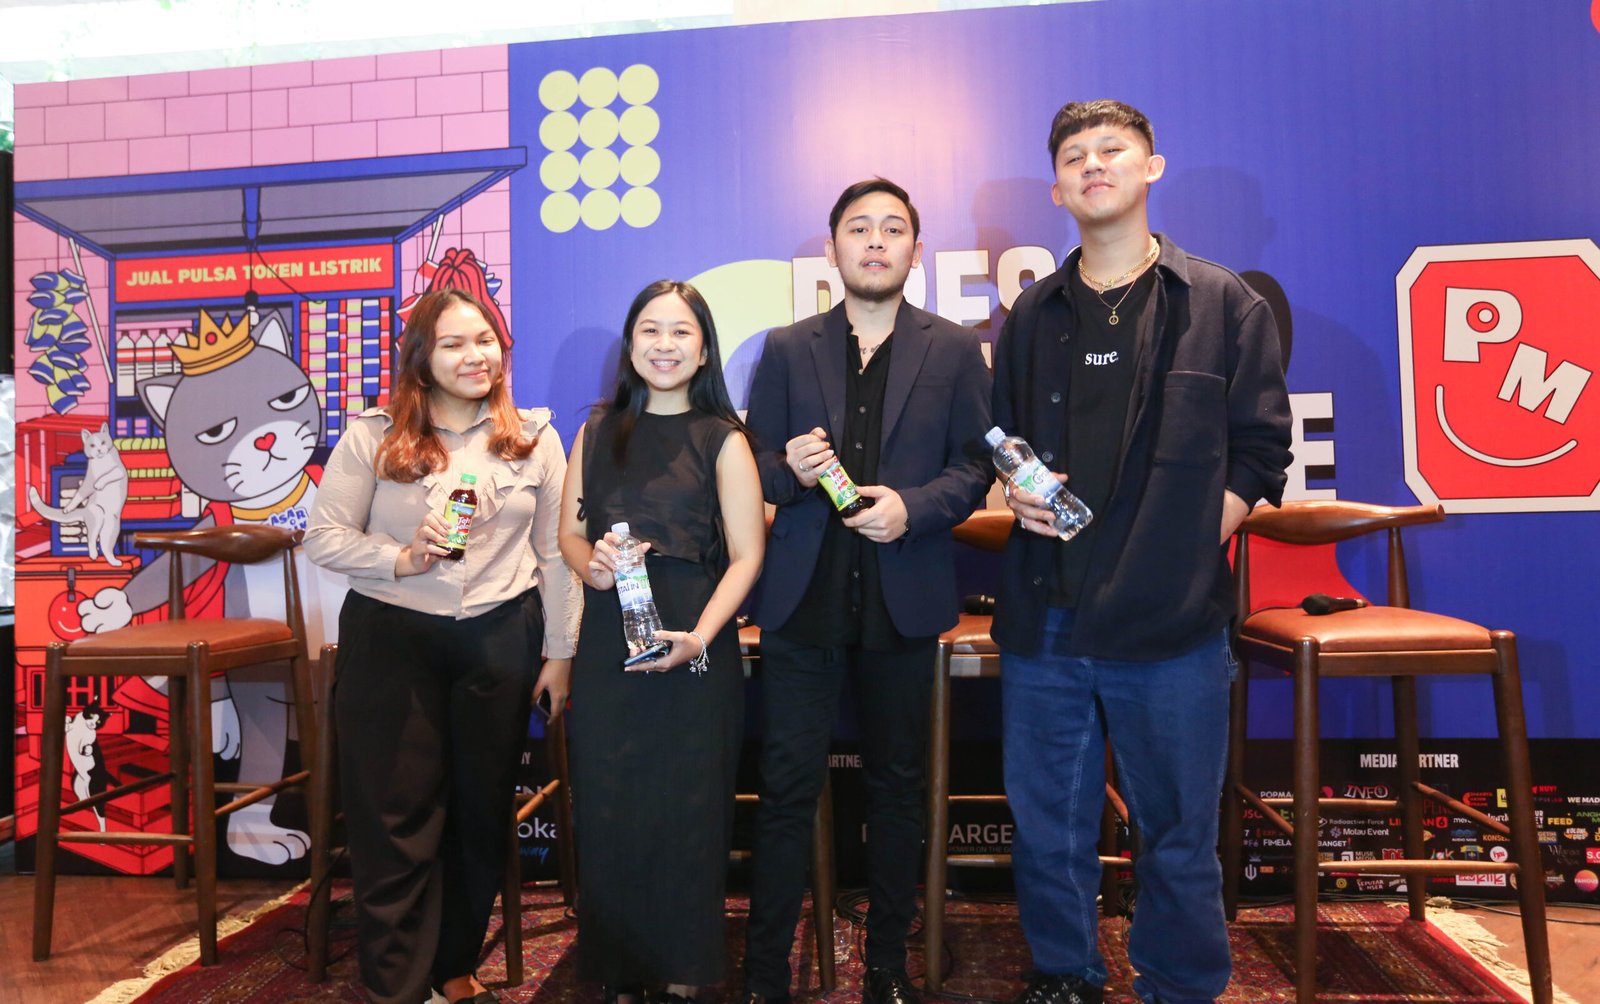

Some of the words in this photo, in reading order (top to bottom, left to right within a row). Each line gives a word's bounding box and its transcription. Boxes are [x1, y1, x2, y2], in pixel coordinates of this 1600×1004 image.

[126, 270, 173, 287] JUAL
[178, 265, 237, 284] PULSA
[243, 261, 304, 280] TOKEN
[309, 256, 382, 276] LISTRIK
[1418, 753, 1460, 768] RTNER
[1547, 817, 1573, 825] FEED
[1367, 828, 1390, 836] Event
[1263, 838, 1292, 846] FIMELA
